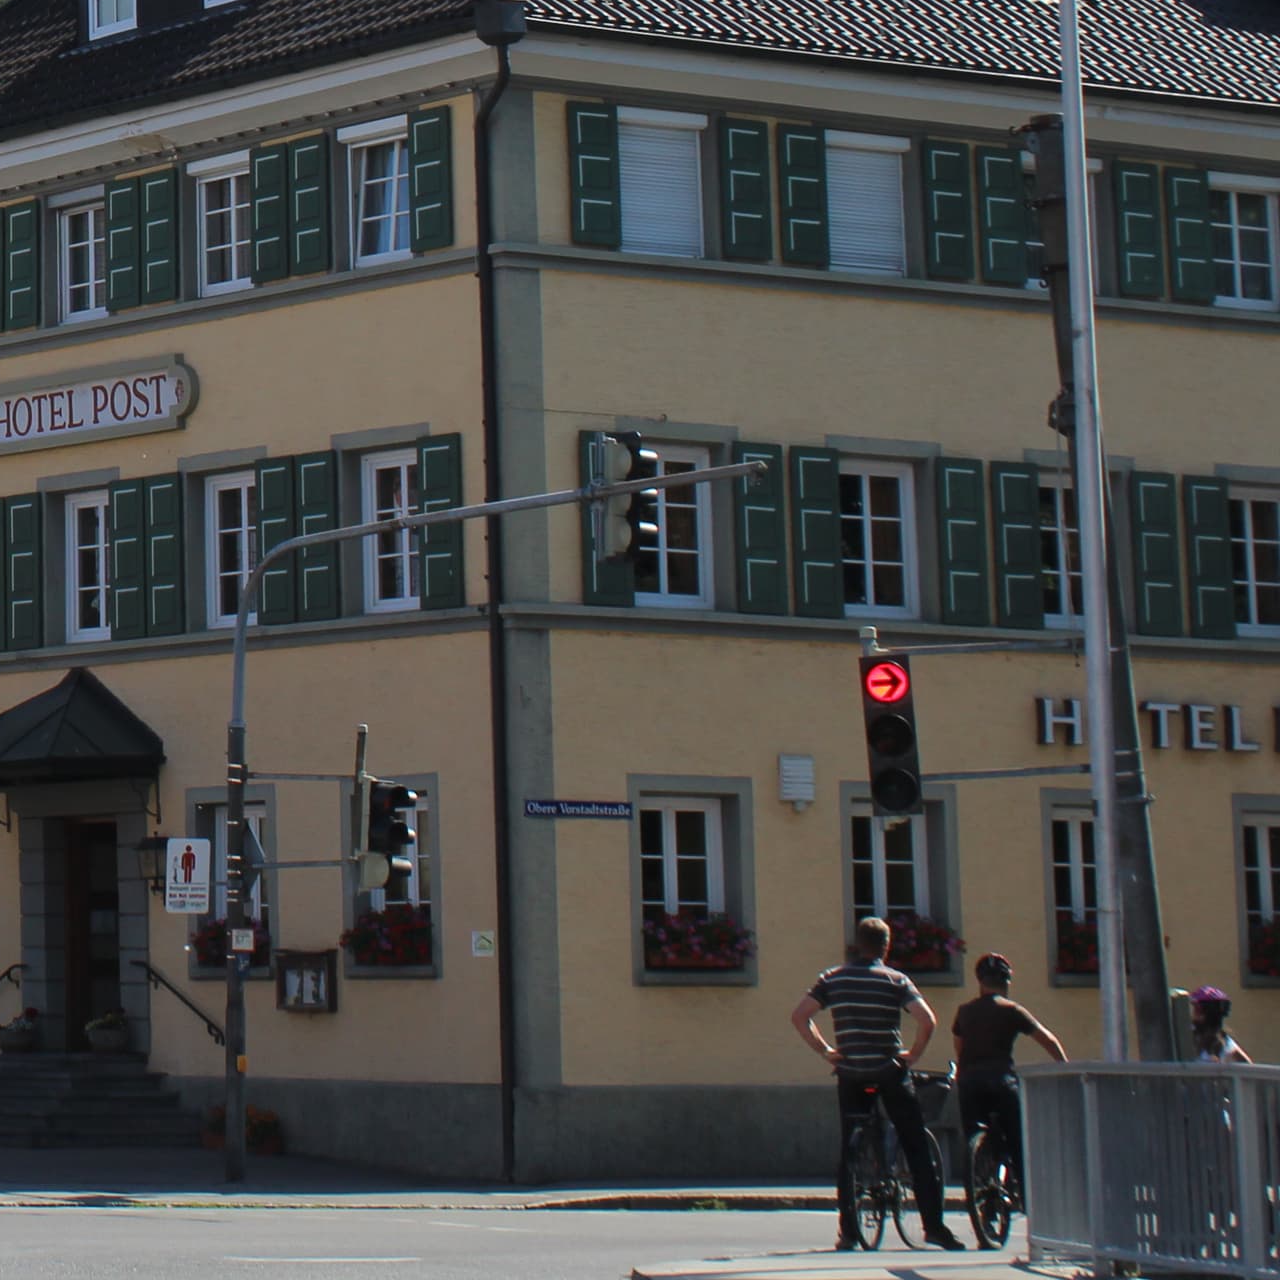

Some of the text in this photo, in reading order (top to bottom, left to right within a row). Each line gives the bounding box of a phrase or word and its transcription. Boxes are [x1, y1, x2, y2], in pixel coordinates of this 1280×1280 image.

[91, 374, 167, 425] POST
[1037, 697, 1261, 752] HTEL
[527, 801, 631, 816] Obere Vorstadtstraße
